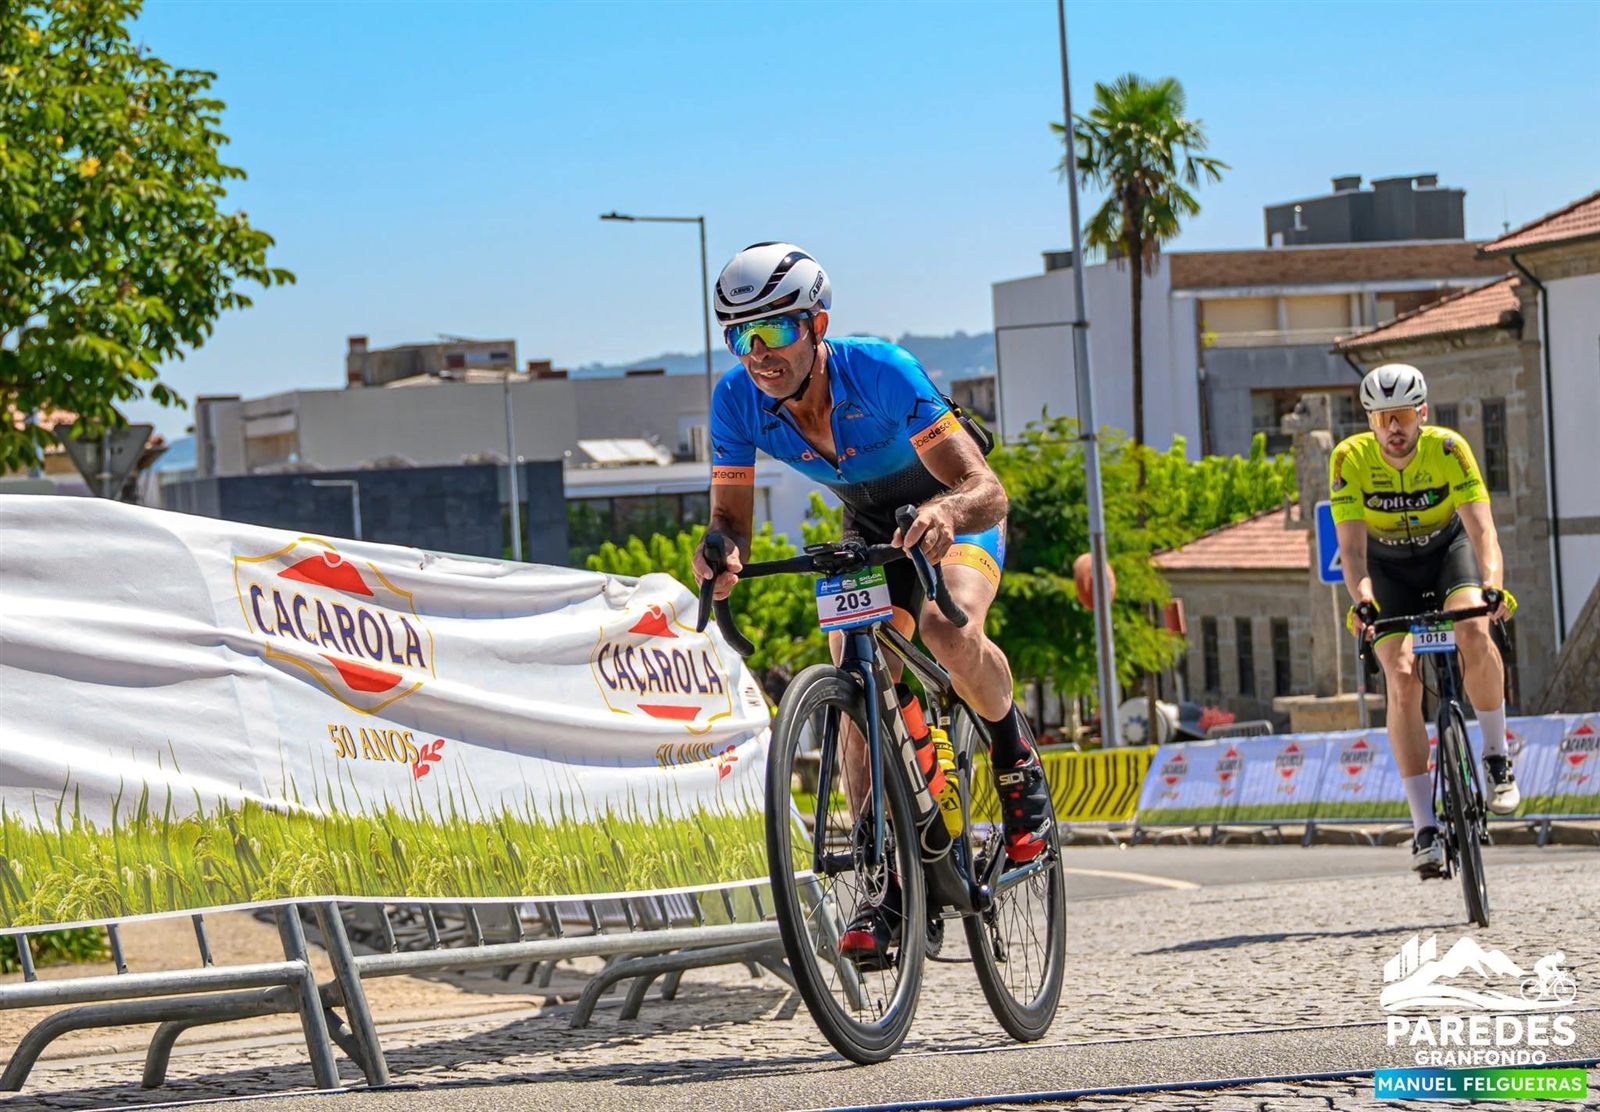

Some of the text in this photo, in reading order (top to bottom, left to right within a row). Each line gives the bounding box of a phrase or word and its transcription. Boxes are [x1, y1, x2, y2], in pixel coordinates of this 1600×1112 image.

[835, 590, 872, 612] 203
[1420, 632, 1447, 643] 1018
[597, 642, 724, 696] CAÇAROLA
[327, 724, 420, 765] 50 ANOS
[999, 771, 1025, 785] SIDI
